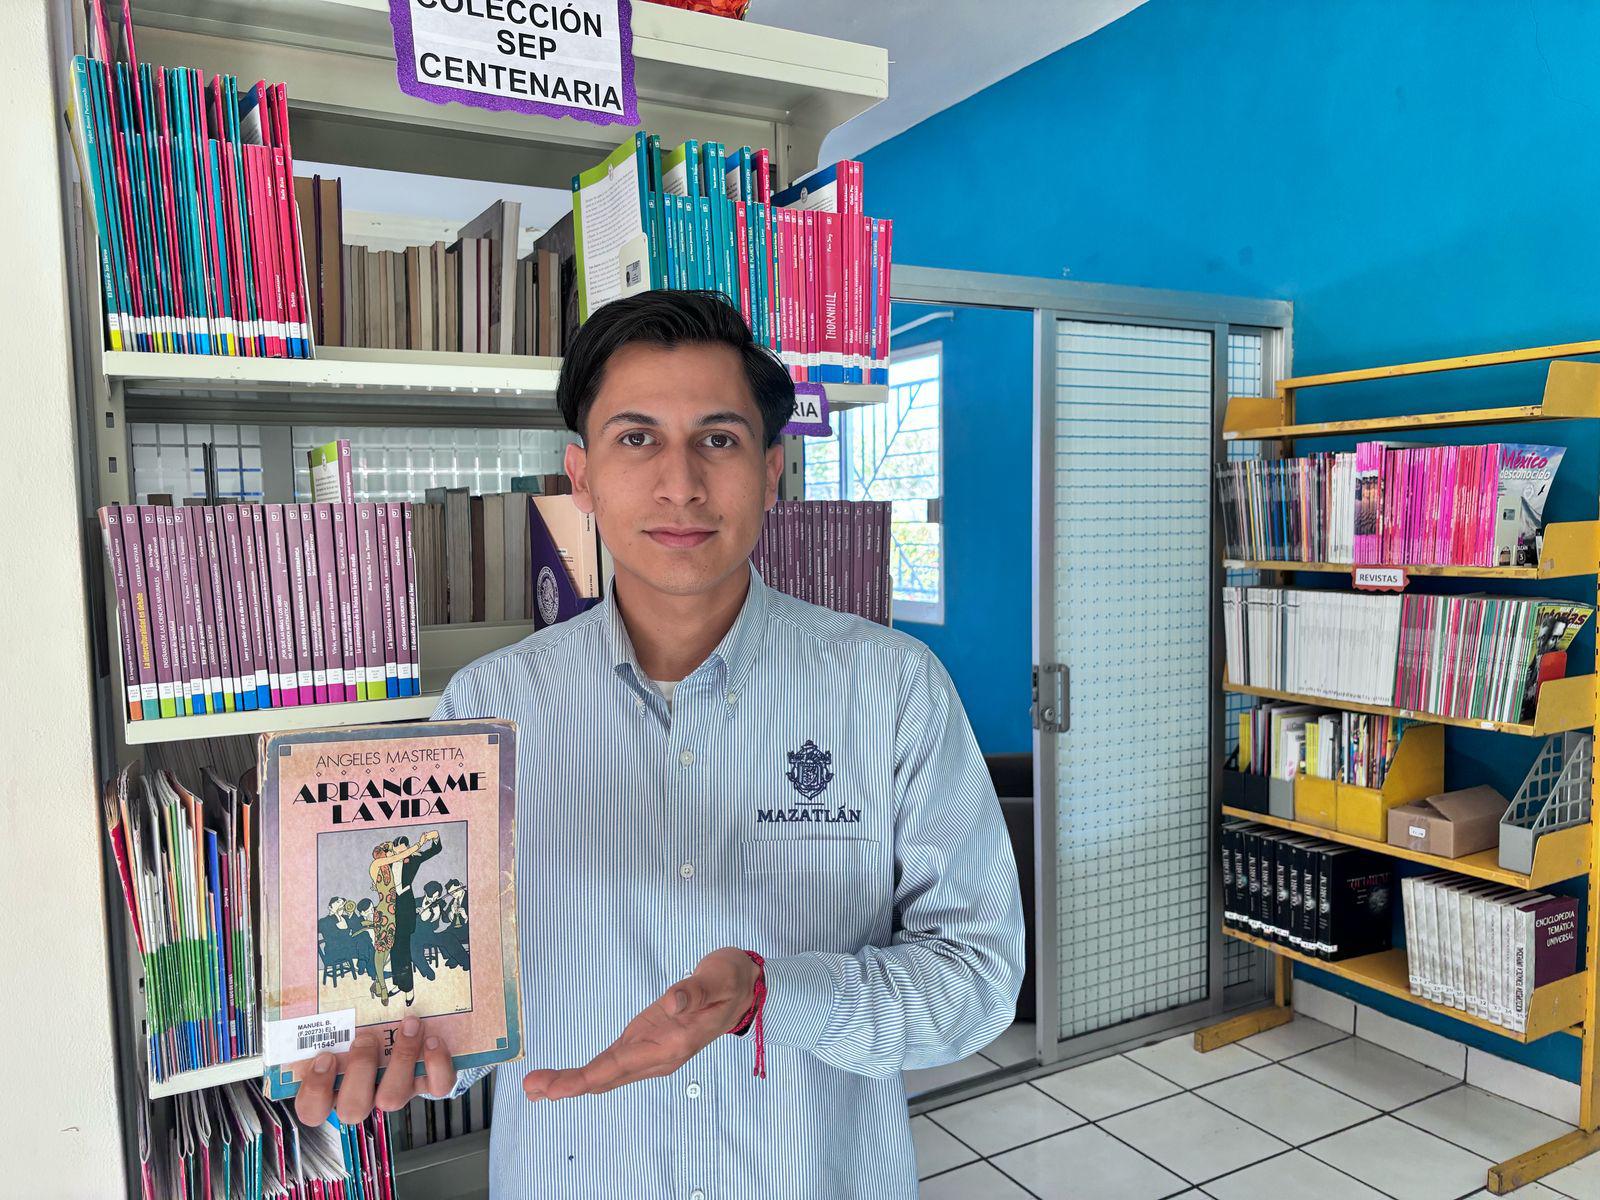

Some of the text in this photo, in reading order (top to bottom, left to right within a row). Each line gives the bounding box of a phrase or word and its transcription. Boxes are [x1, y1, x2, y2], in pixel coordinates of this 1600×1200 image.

[497, 29, 557, 60] SEP
[419, 52, 622, 111] CENTENARIA
[825, 292, 837, 340] THORNHILL
[1502, 447, 1549, 470] México
[1499, 468, 1551, 481] desconocido
[1359, 573, 1398, 583] REVISTAS
[136, 592, 144, 610] debate
[154, 577, 162, 603] NATURALES
[139, 618, 150, 662] interculturalidad
[354, 620, 362, 648] comprensión
[161, 641, 169, 668] ENSEÑANZA
[316, 747, 465, 769] ANGELES MASTRETTA
[292, 771, 487, 805] ARRANCAME
[332, 795, 450, 824] LA VIDA
[757, 802, 861, 823] MAZATLÁN
[1536, 910, 1575, 928] ENCICLOPEDIA
[1546, 932, 1574, 947] UNIVERSAL
[297, 1021, 324, 1031] MANUEL
[297, 1027, 324, 1038] (F.20273)
[313, 1040, 335, 1050] 11545
